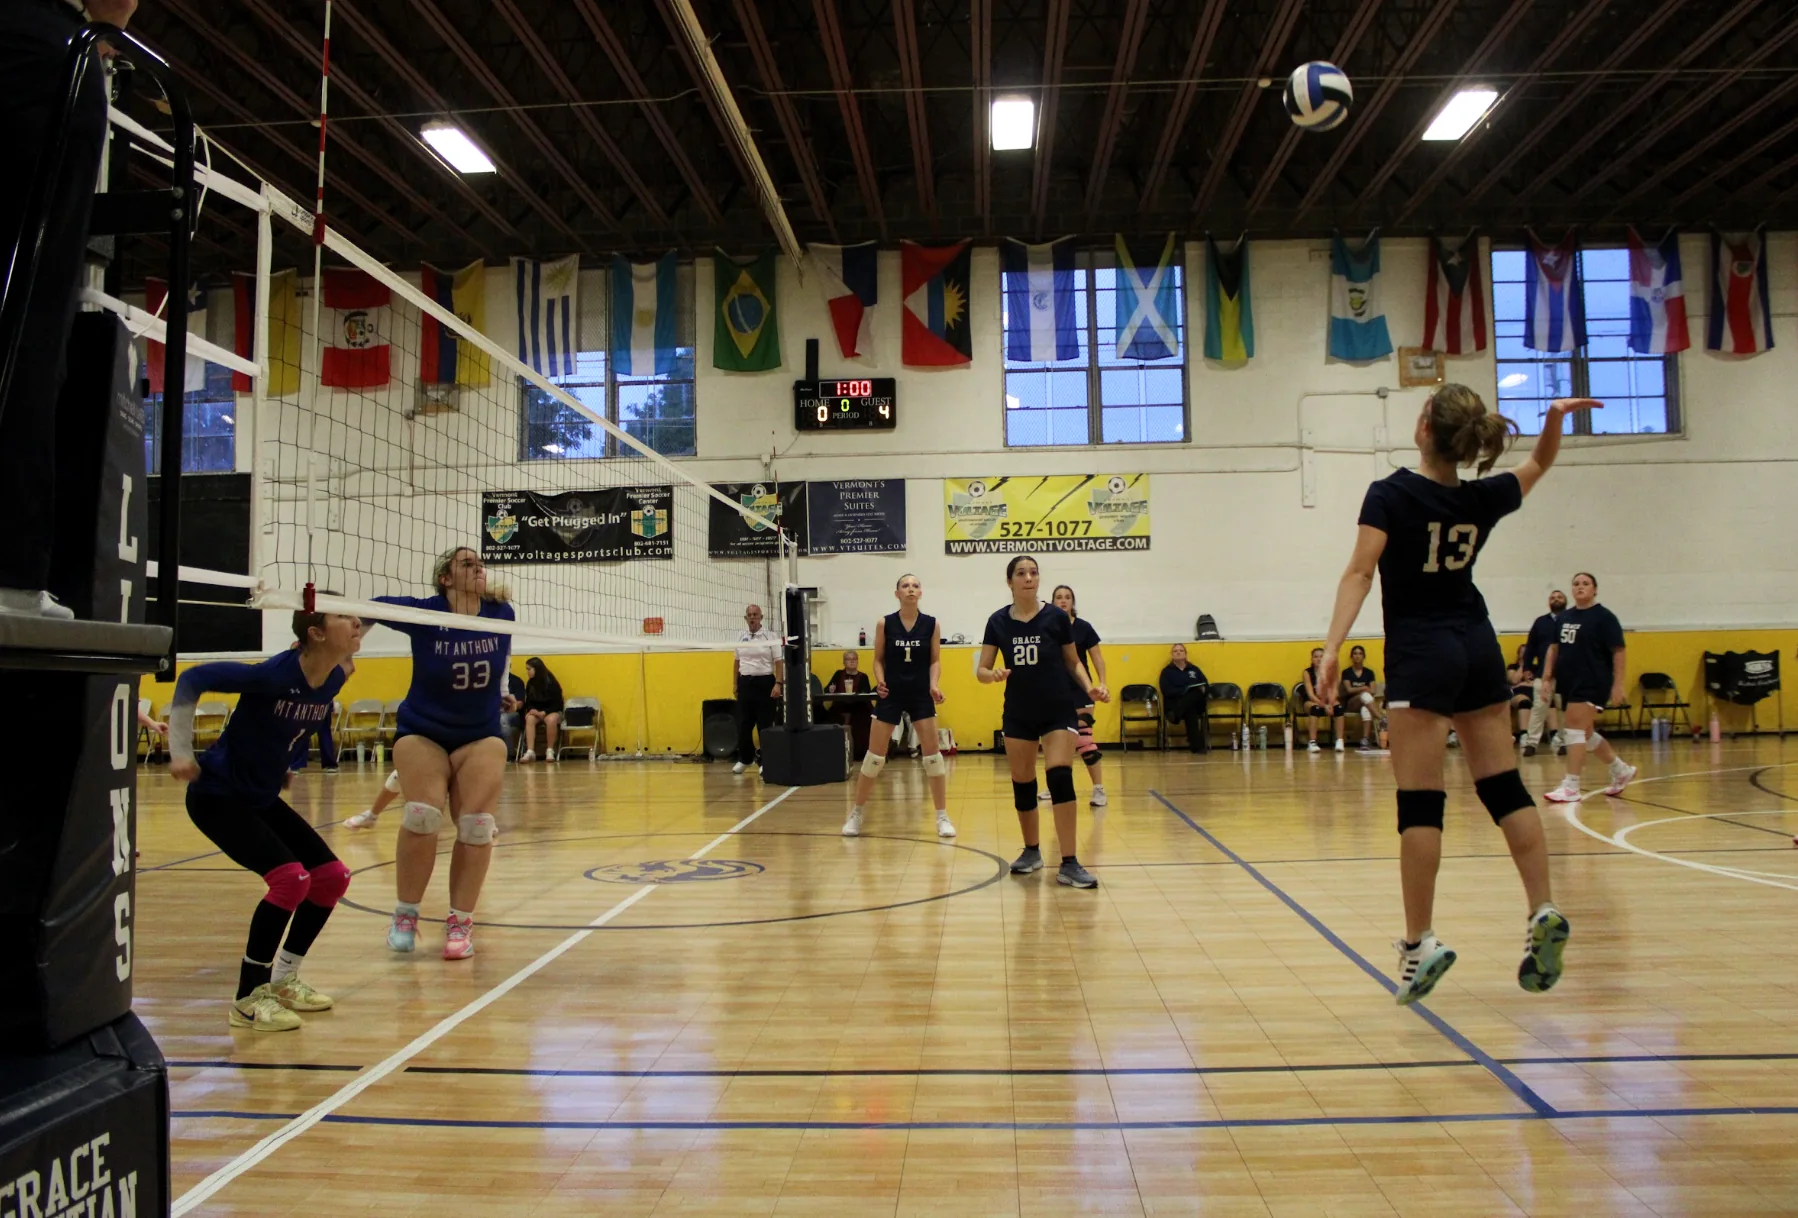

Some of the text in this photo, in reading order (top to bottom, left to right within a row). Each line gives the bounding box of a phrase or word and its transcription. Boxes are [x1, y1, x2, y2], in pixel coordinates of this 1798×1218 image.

[836, 380, 870, 396] 1:00
[800, 399, 830, 407] HOME
[841, 399, 850, 412] 0
[860, 397, 891, 406] GUEST
[817, 406, 828, 422] 0
[878, 405, 889, 419] 4
[833, 480, 885, 489] VERMONT'S
[840, 492, 879, 500] PREMIER
[844, 502, 875, 510] SUITES
[552, 513, 605, 529] Plugged
[1000, 520, 1092, 537] 527-1077
[813, 543, 906, 552] WWW.VTSUITES.COM
[951, 538, 1147, 553] WWW.VERMONTVOLTAGE.COM
[1422, 522, 1478, 572] 13
[482, 547, 673, 561] www.voltagesportsclub.com
[1013, 635, 1041, 644] GRACE
[1560, 629, 1576, 644] 50
[435, 637, 499, 656] MT ANTHONY
[904, 647, 912, 662] 1
[1013, 645, 1039, 666] 20
[452, 660, 490, 690] 33
[274, 700, 293, 718] MT
